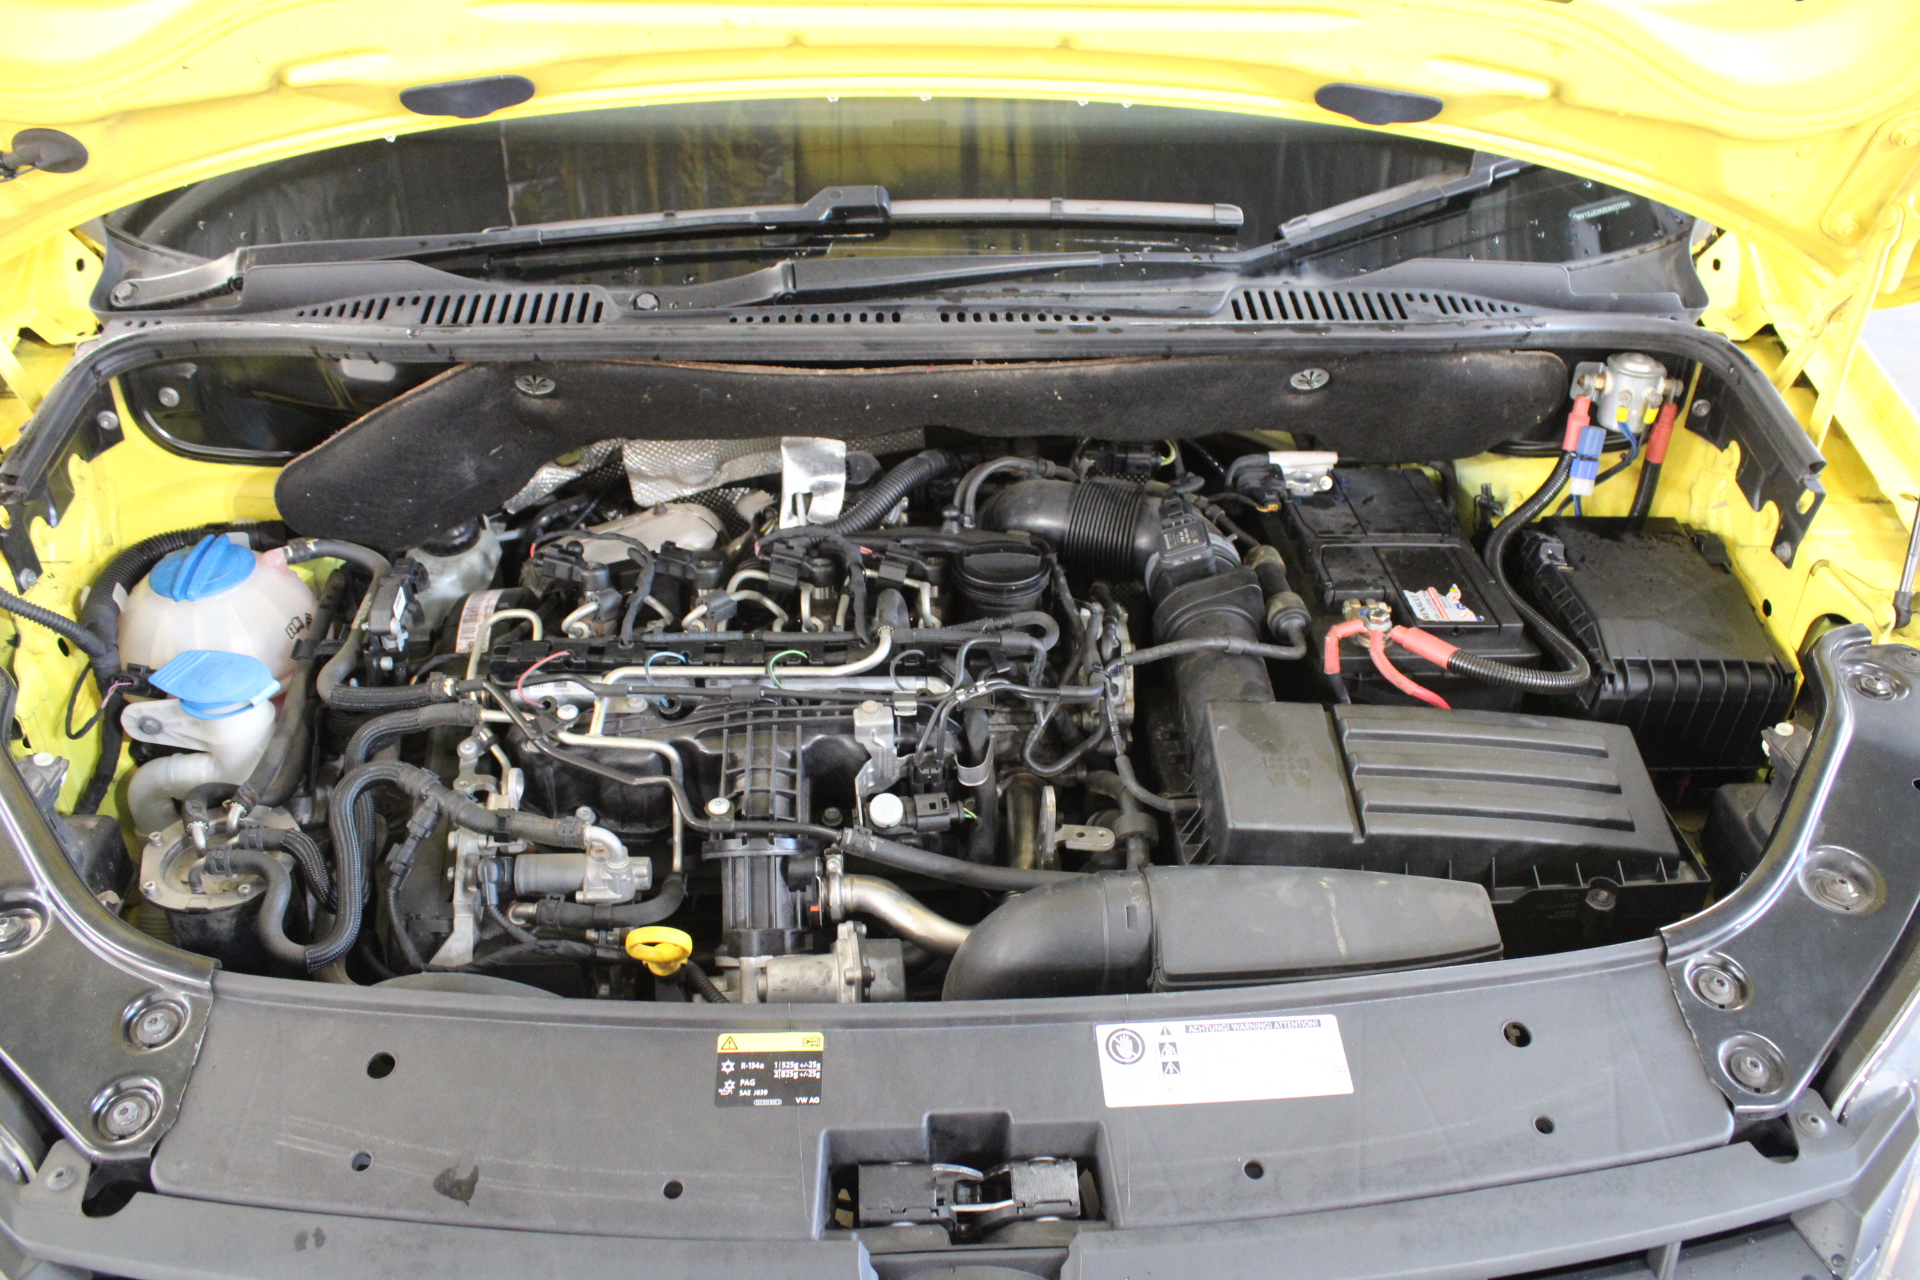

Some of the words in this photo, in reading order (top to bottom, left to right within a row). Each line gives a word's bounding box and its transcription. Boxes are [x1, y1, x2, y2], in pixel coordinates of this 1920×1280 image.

[1188, 1024, 1230, 1033] ACHTUNG!
[1232, 1022, 1273, 1031] WARNING!
[1275, 1020, 1319, 1029] ATTENTION!
[740, 1061, 765, 1070] R-134a
[809, 1096, 820, 1104] AG
